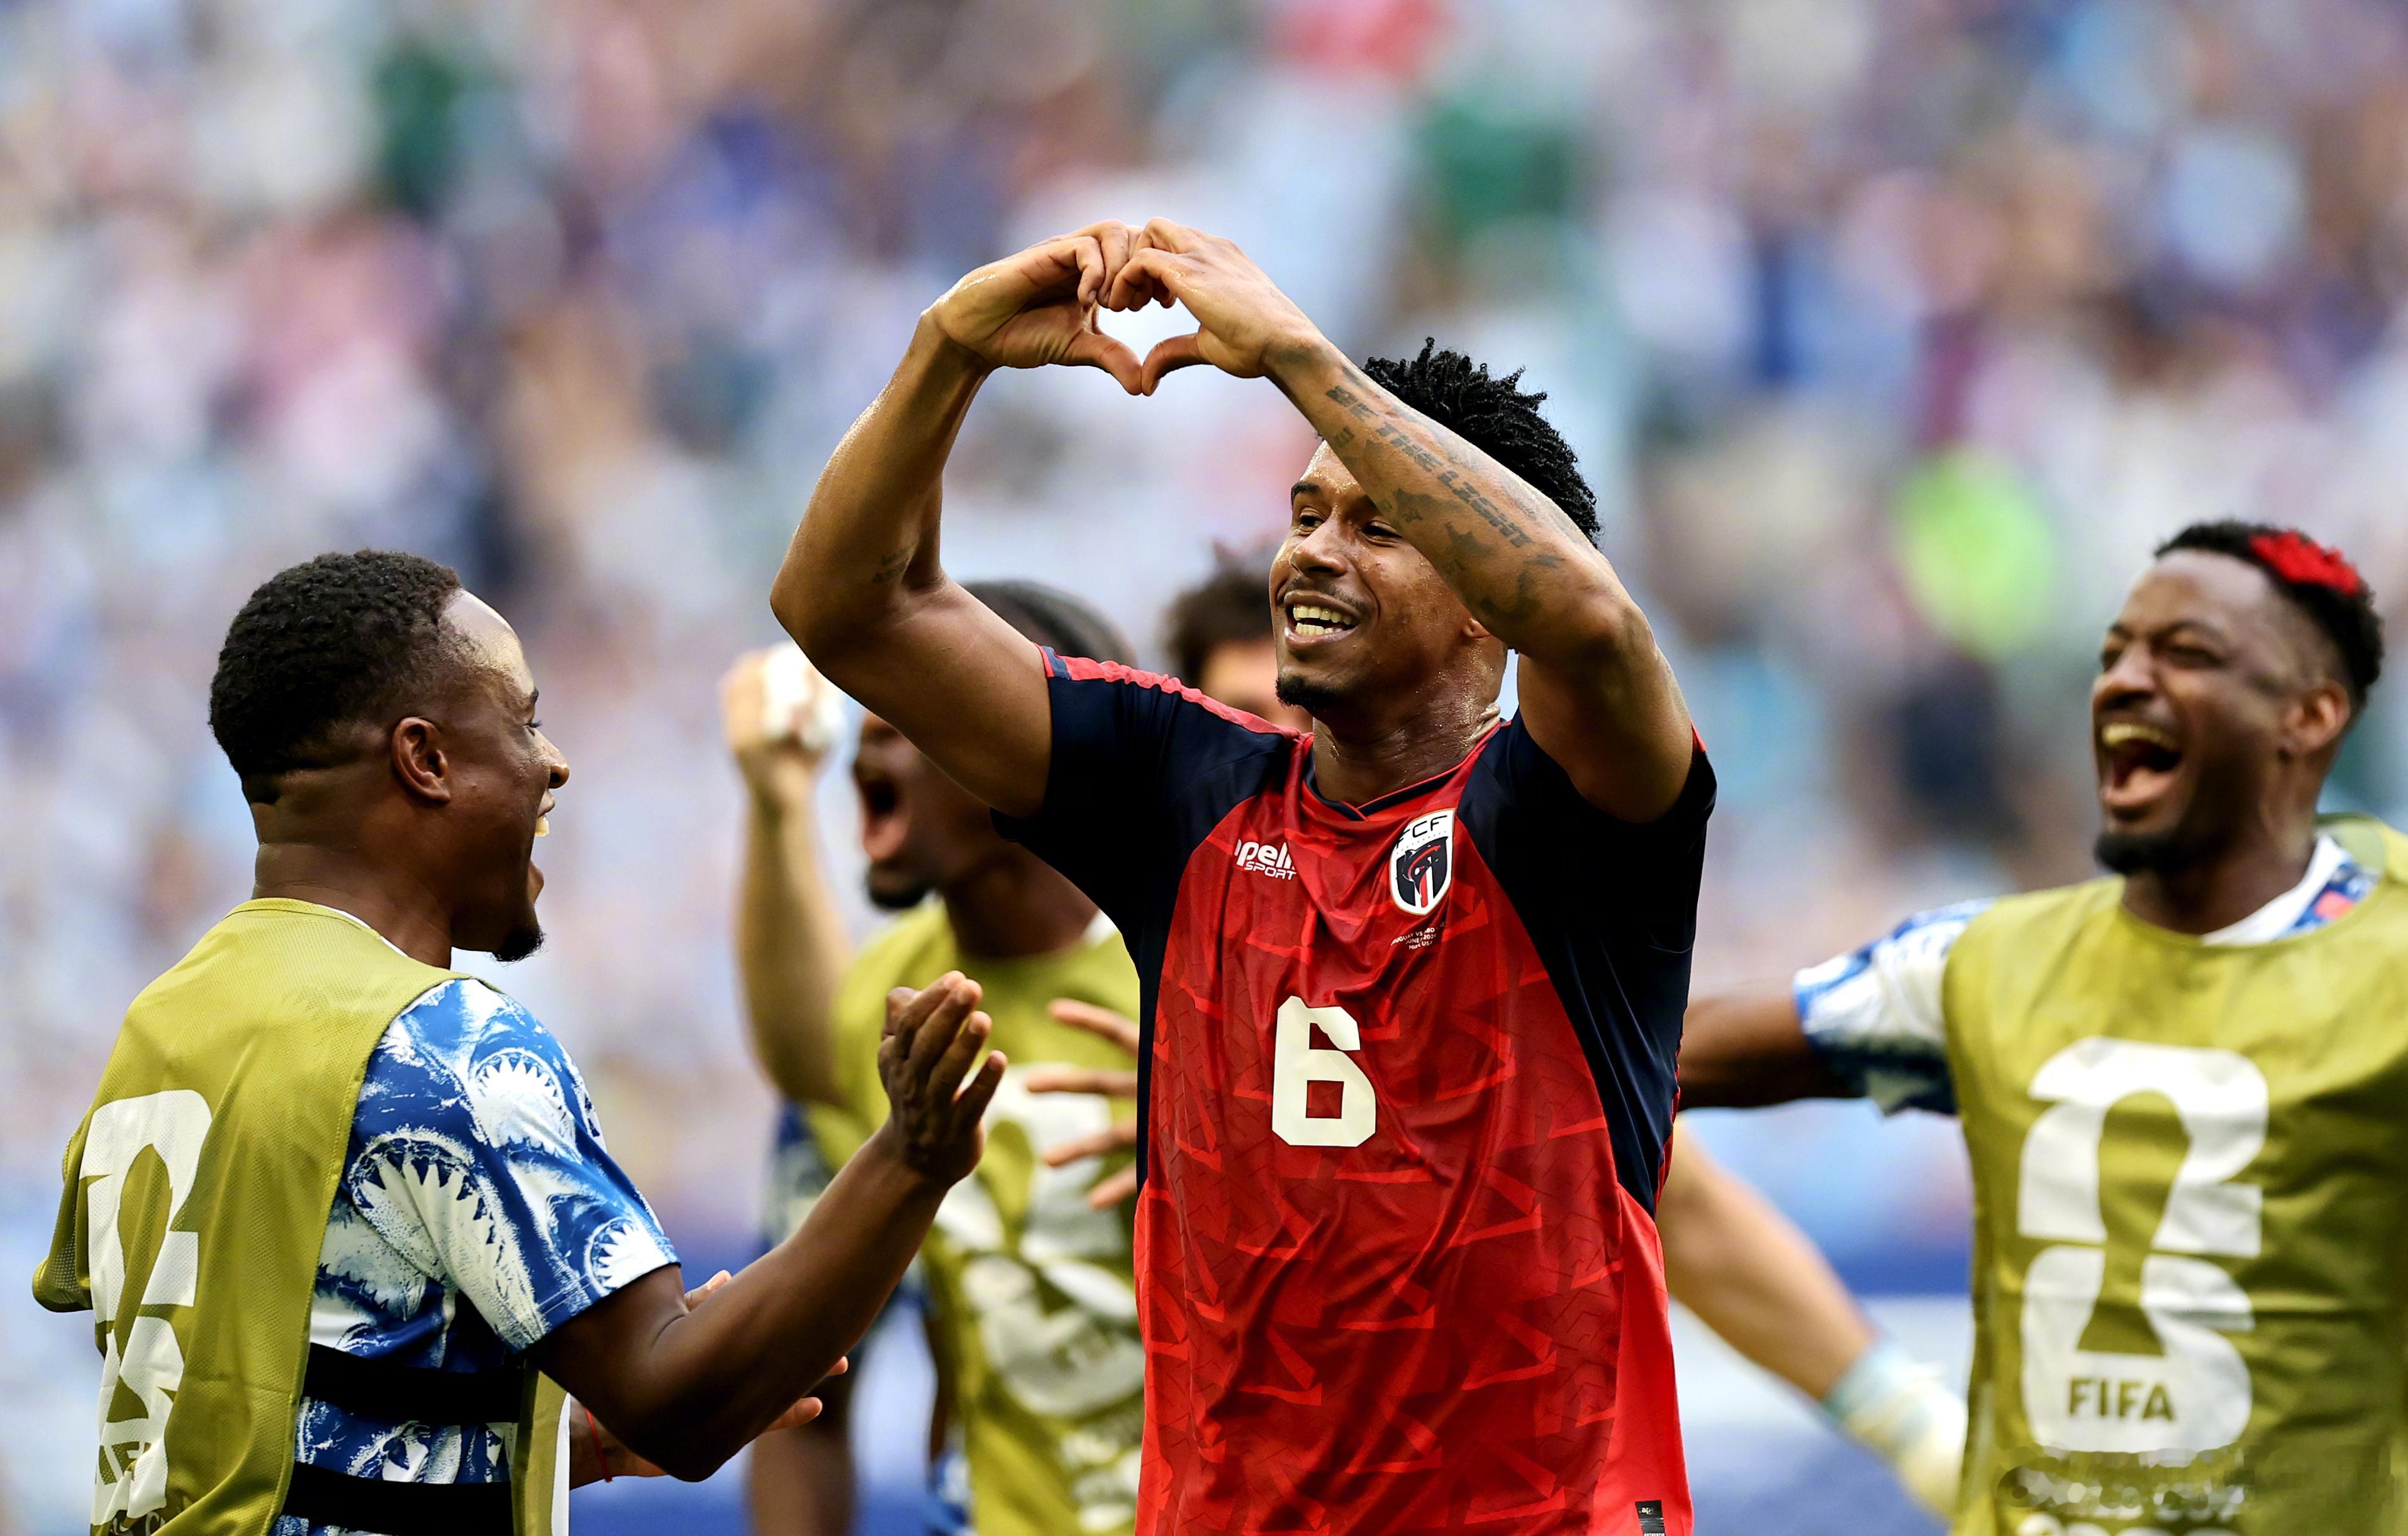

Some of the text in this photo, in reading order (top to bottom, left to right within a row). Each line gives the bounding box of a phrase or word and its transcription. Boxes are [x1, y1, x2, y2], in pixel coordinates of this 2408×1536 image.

[1376, 421, 1444, 473] THE
[1437, 469, 1534, 547] LIGHT
[1395, 814, 1448, 849] FCF
[1244, 861, 1297, 880] SPORT
[1272, 995, 1376, 1147] 6
[2068, 1379, 2175, 1421] FIFA
